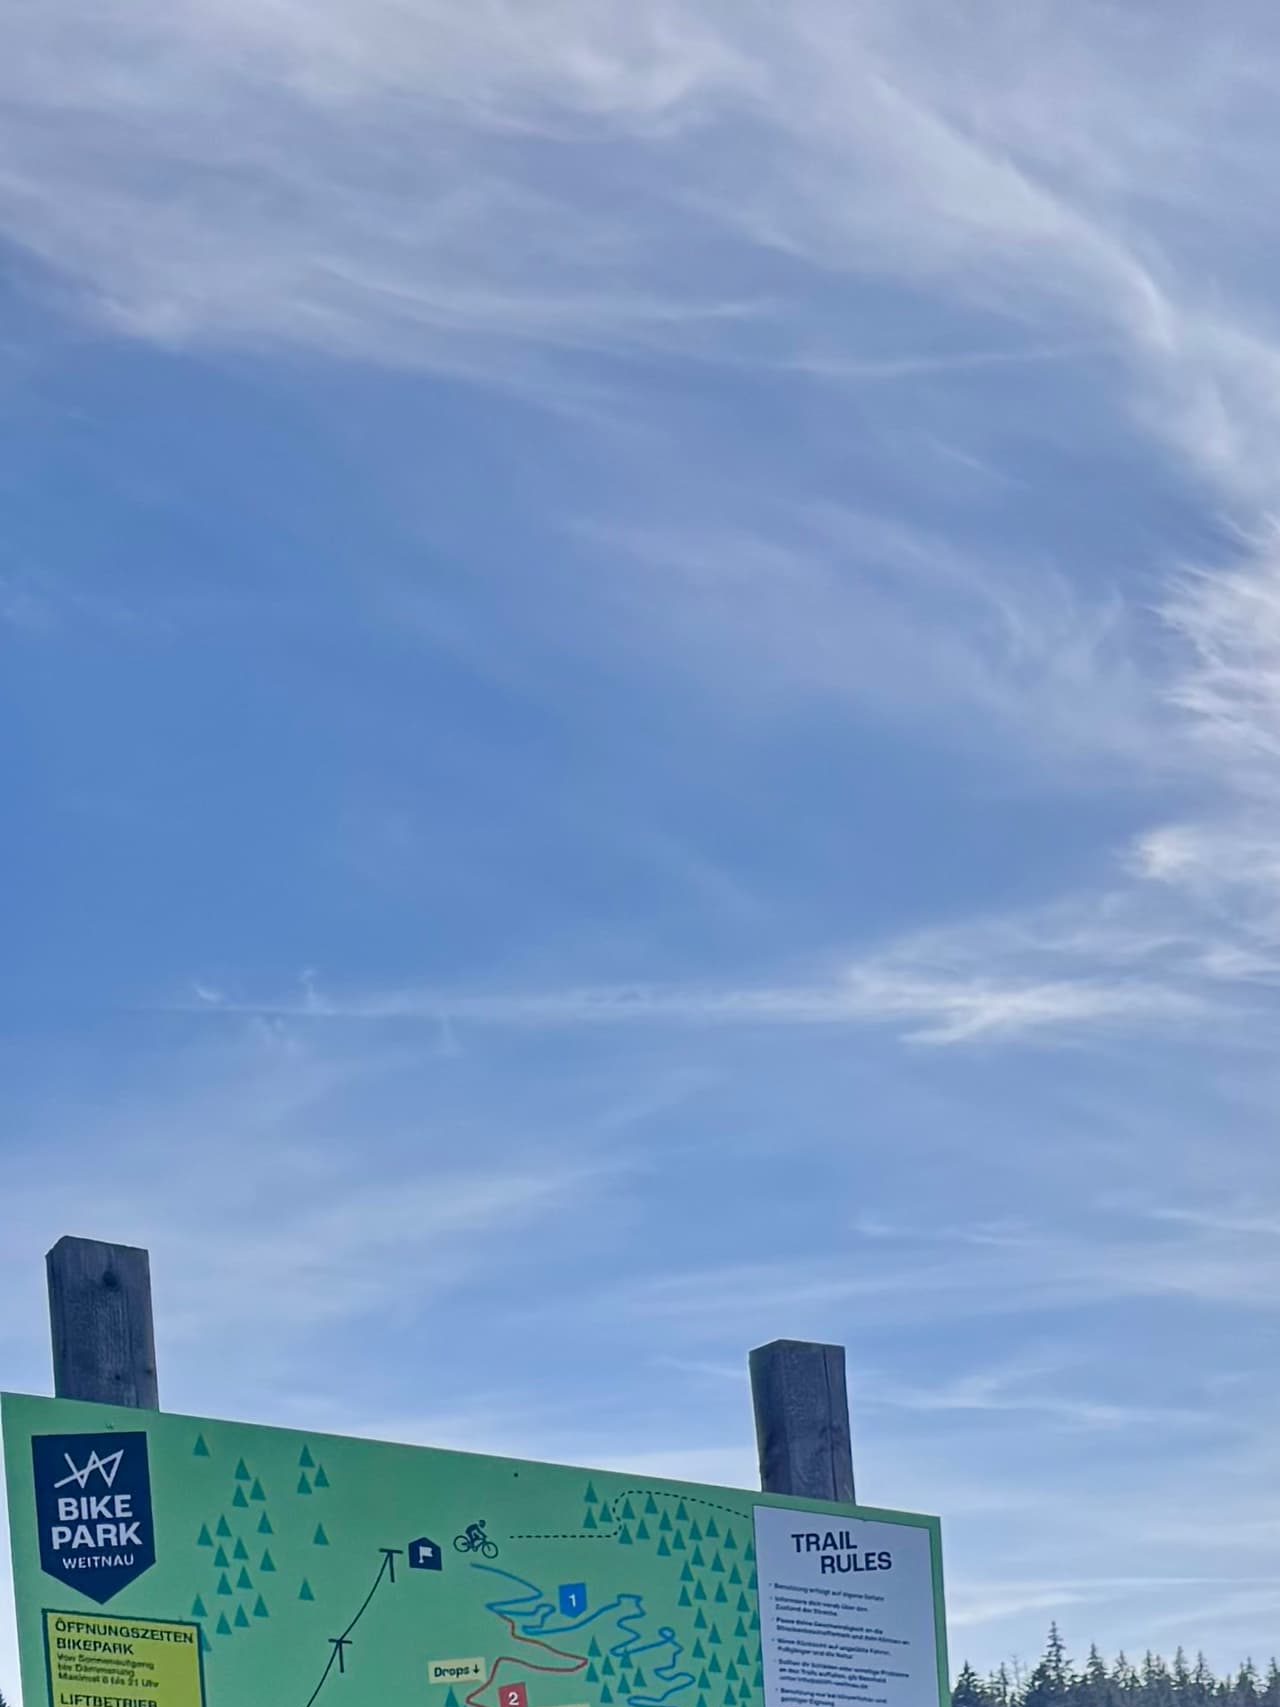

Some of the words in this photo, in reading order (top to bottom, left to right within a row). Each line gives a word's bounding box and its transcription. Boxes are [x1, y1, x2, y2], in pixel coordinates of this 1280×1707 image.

[58, 1494, 133, 1521] BIKE
[51, 1522, 143, 1550] PARK
[791, 1531, 858, 1553] TRAIL
[62, 1554, 134, 1569] WEITNAU
[820, 1551, 892, 1575] RULES
[568, 1595, 577, 1608] 1
[55, 1617, 194, 1644] ÖFFNUNGSZEITEN
[56, 1638, 134, 1655] BIKEPARK
[434, 1665, 470, 1679] Drops
[508, 1693, 519, 1706] 2
